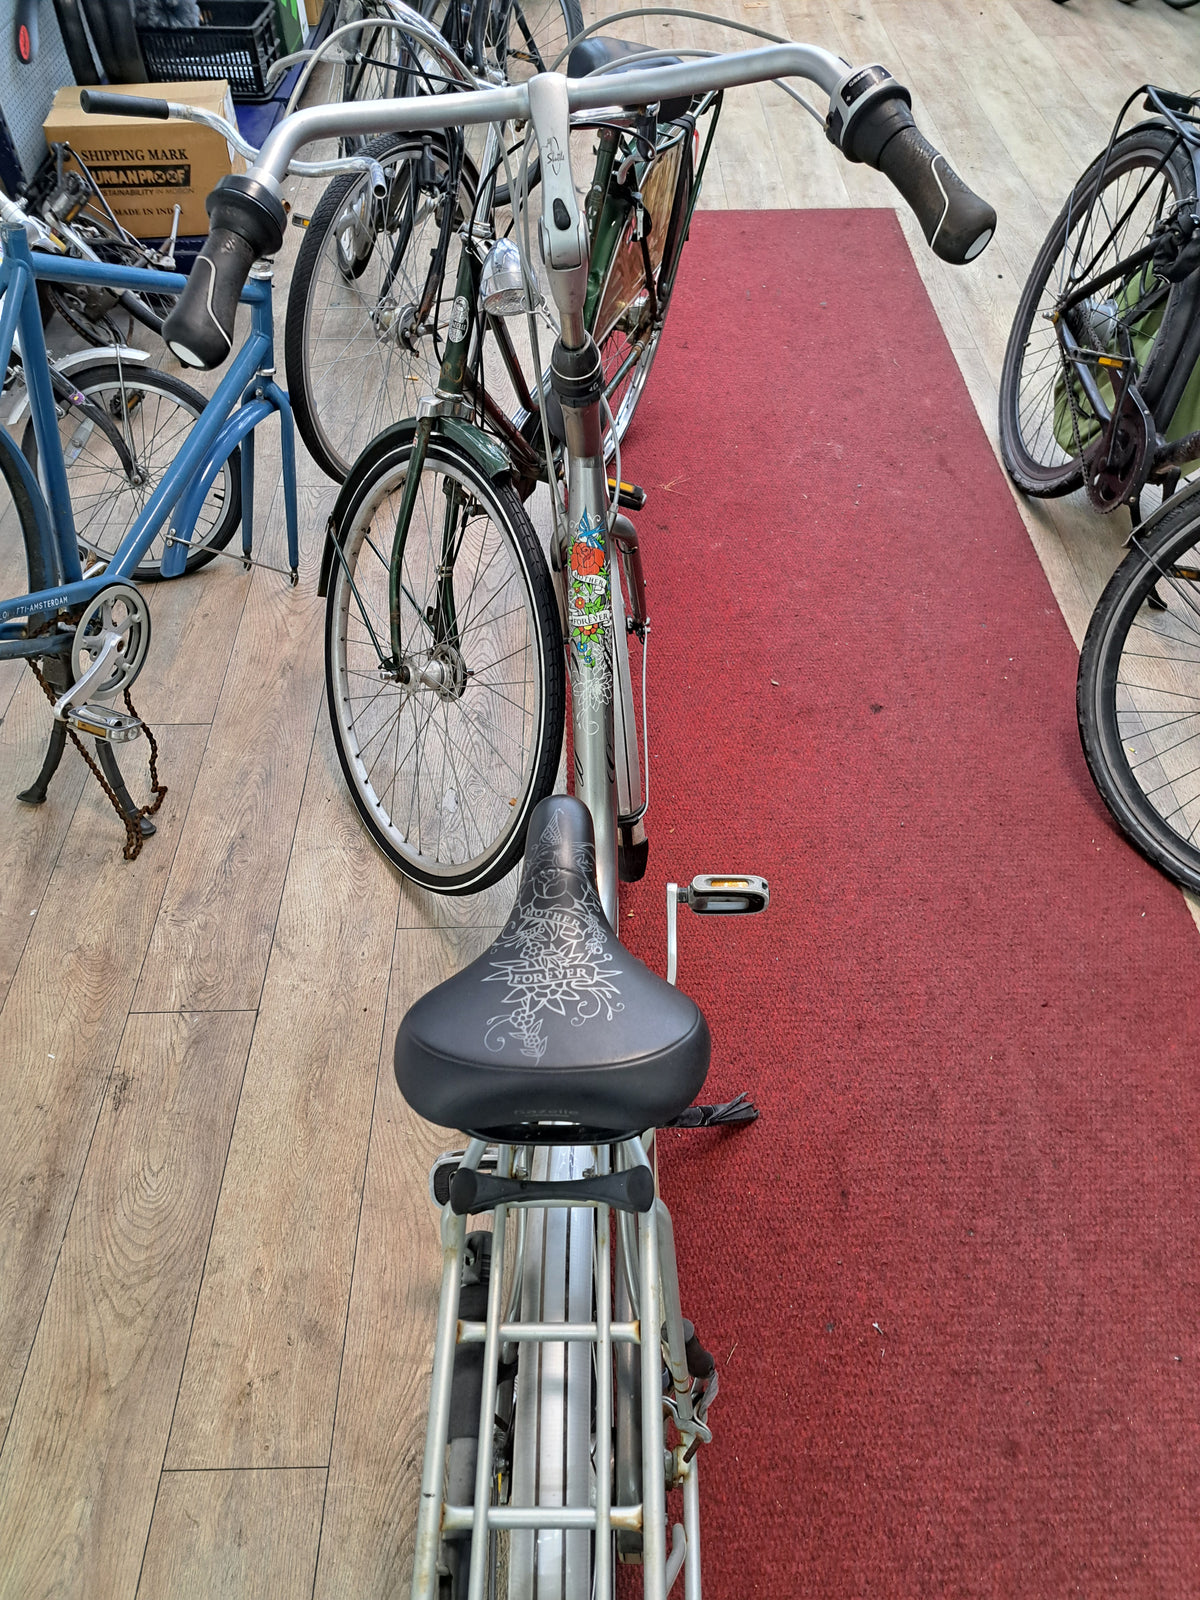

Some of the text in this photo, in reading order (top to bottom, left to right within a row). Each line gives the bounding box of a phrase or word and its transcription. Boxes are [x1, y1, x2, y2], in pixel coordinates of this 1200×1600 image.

[81, 148, 188, 162] SHIPPING MARK
[91, 169, 186, 184] URBANPROOF
[101, 188, 153, 197] STAINABILITY
[113, 207, 140, 217] MADE
[573, 613, 608, 625] FOREVER
[525, 907, 581, 928] MOTHER
[513, 967, 592, 984] FOREVER
